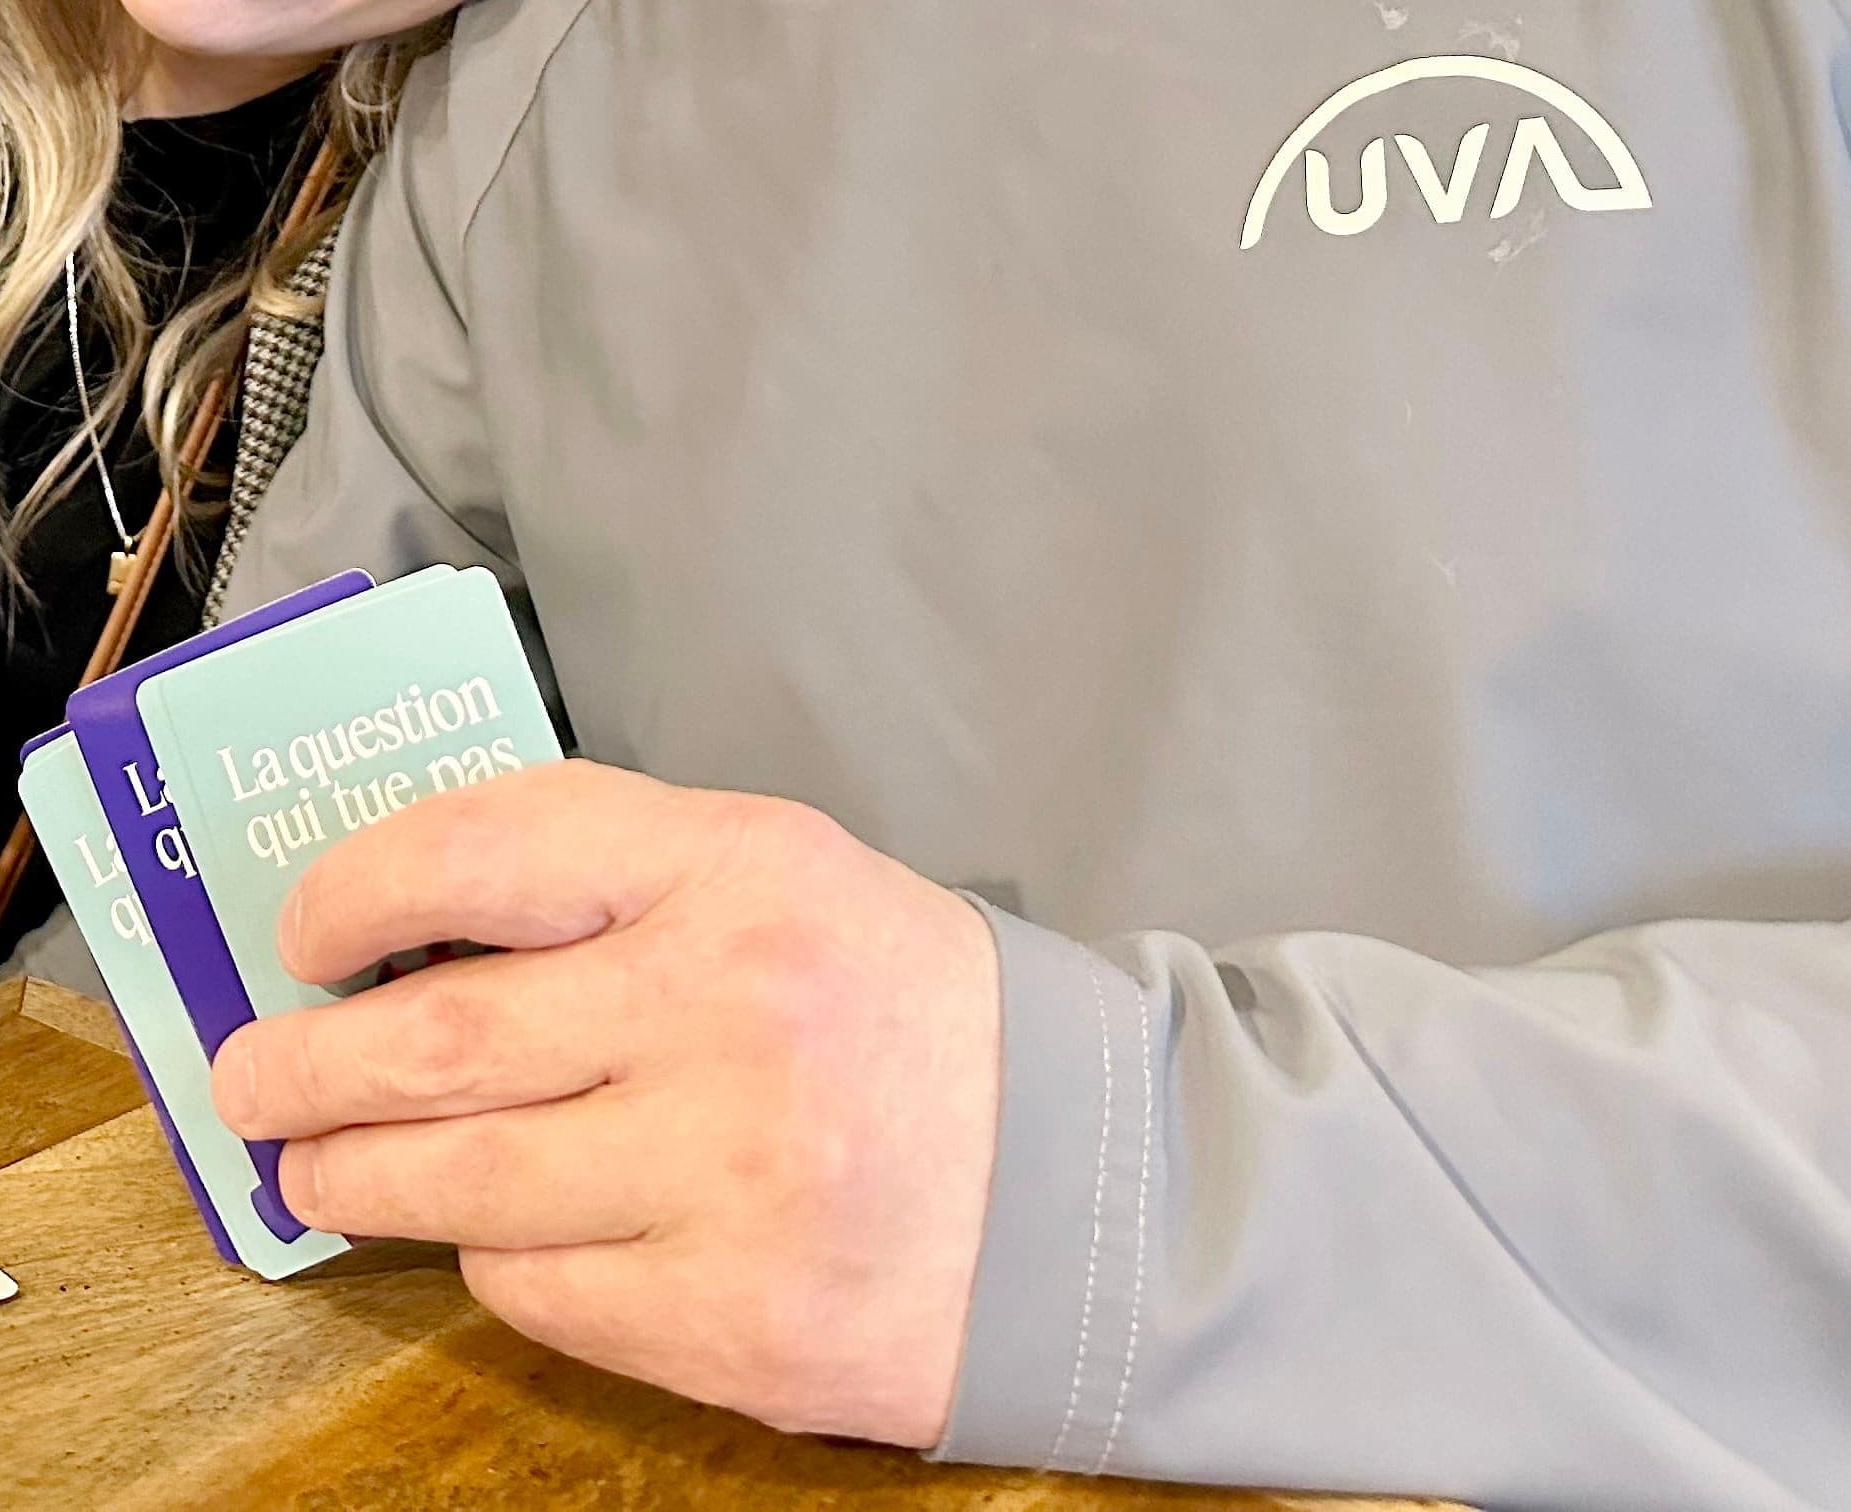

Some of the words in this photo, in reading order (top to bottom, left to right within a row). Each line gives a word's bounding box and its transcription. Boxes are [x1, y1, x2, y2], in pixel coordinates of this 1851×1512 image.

[1303, 115, 1652, 236] UVA
[216, 745, 289, 801] La
[288, 676, 502, 788] question
[245, 787, 328, 868] qui
[331, 770, 417, 832] tue
